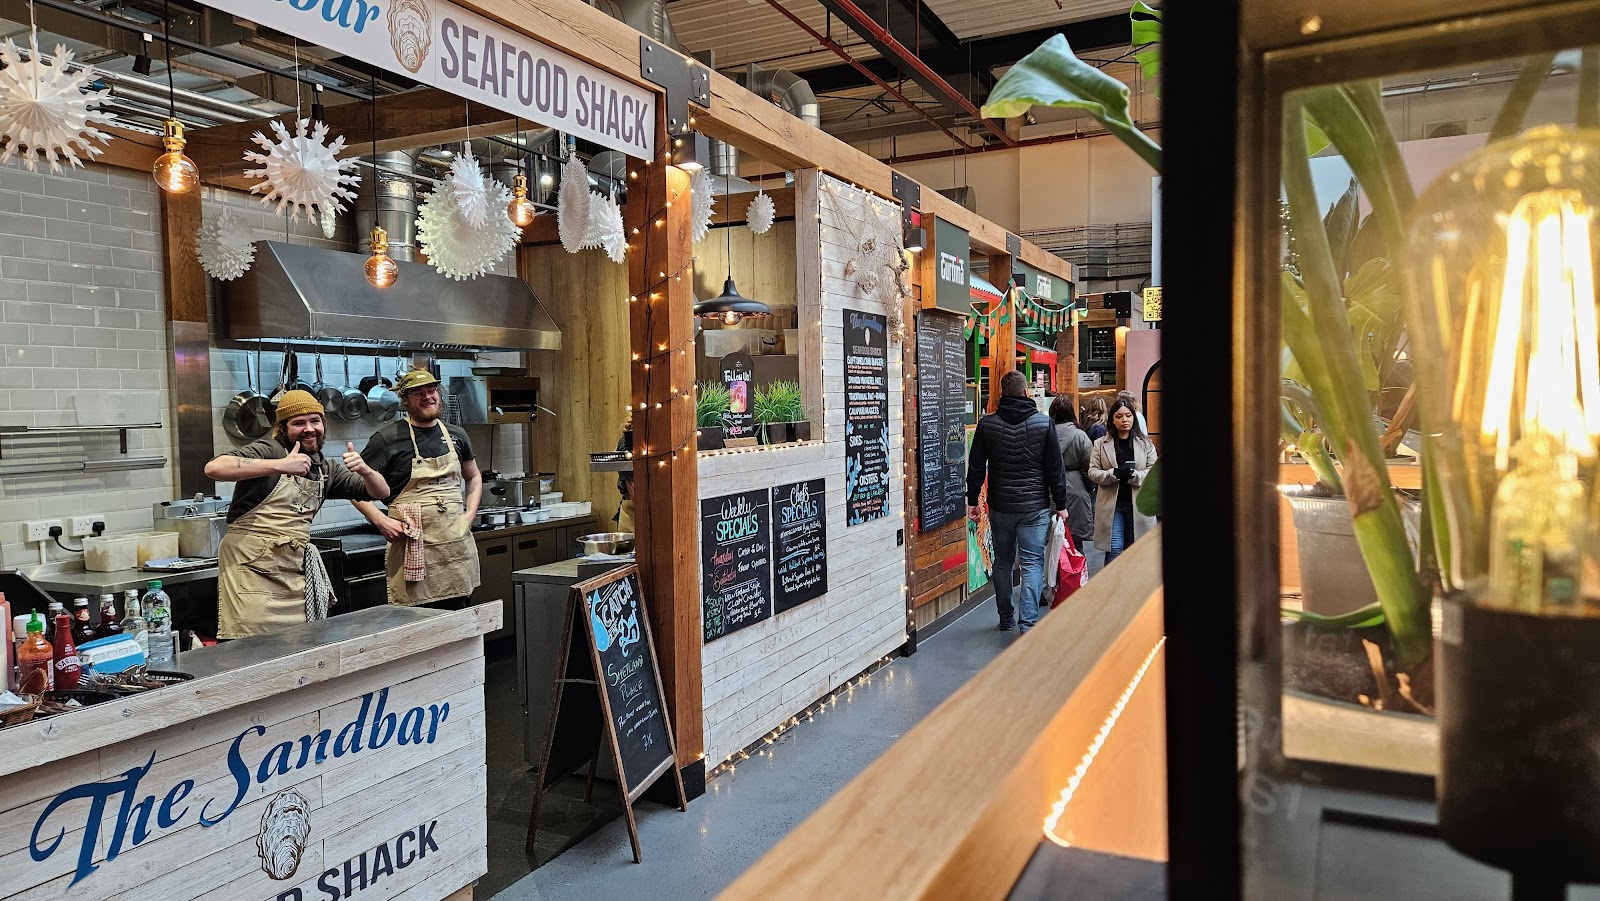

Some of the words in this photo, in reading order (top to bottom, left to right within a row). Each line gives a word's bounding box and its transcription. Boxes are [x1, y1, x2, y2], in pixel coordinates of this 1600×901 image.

[440, 17, 569, 119] SEAFOOD
[575, 74, 648, 150] SHACK
[716, 514, 759, 541] SPECIALS
[721, 496, 752, 521] Weekly
[781, 500, 818, 524] SPECIALS
[602, 577, 633, 627] CATCH
[29, 750, 196, 888] The
[200, 687, 450, 828] Sandbar
[317, 820, 439, 901] SHACK
